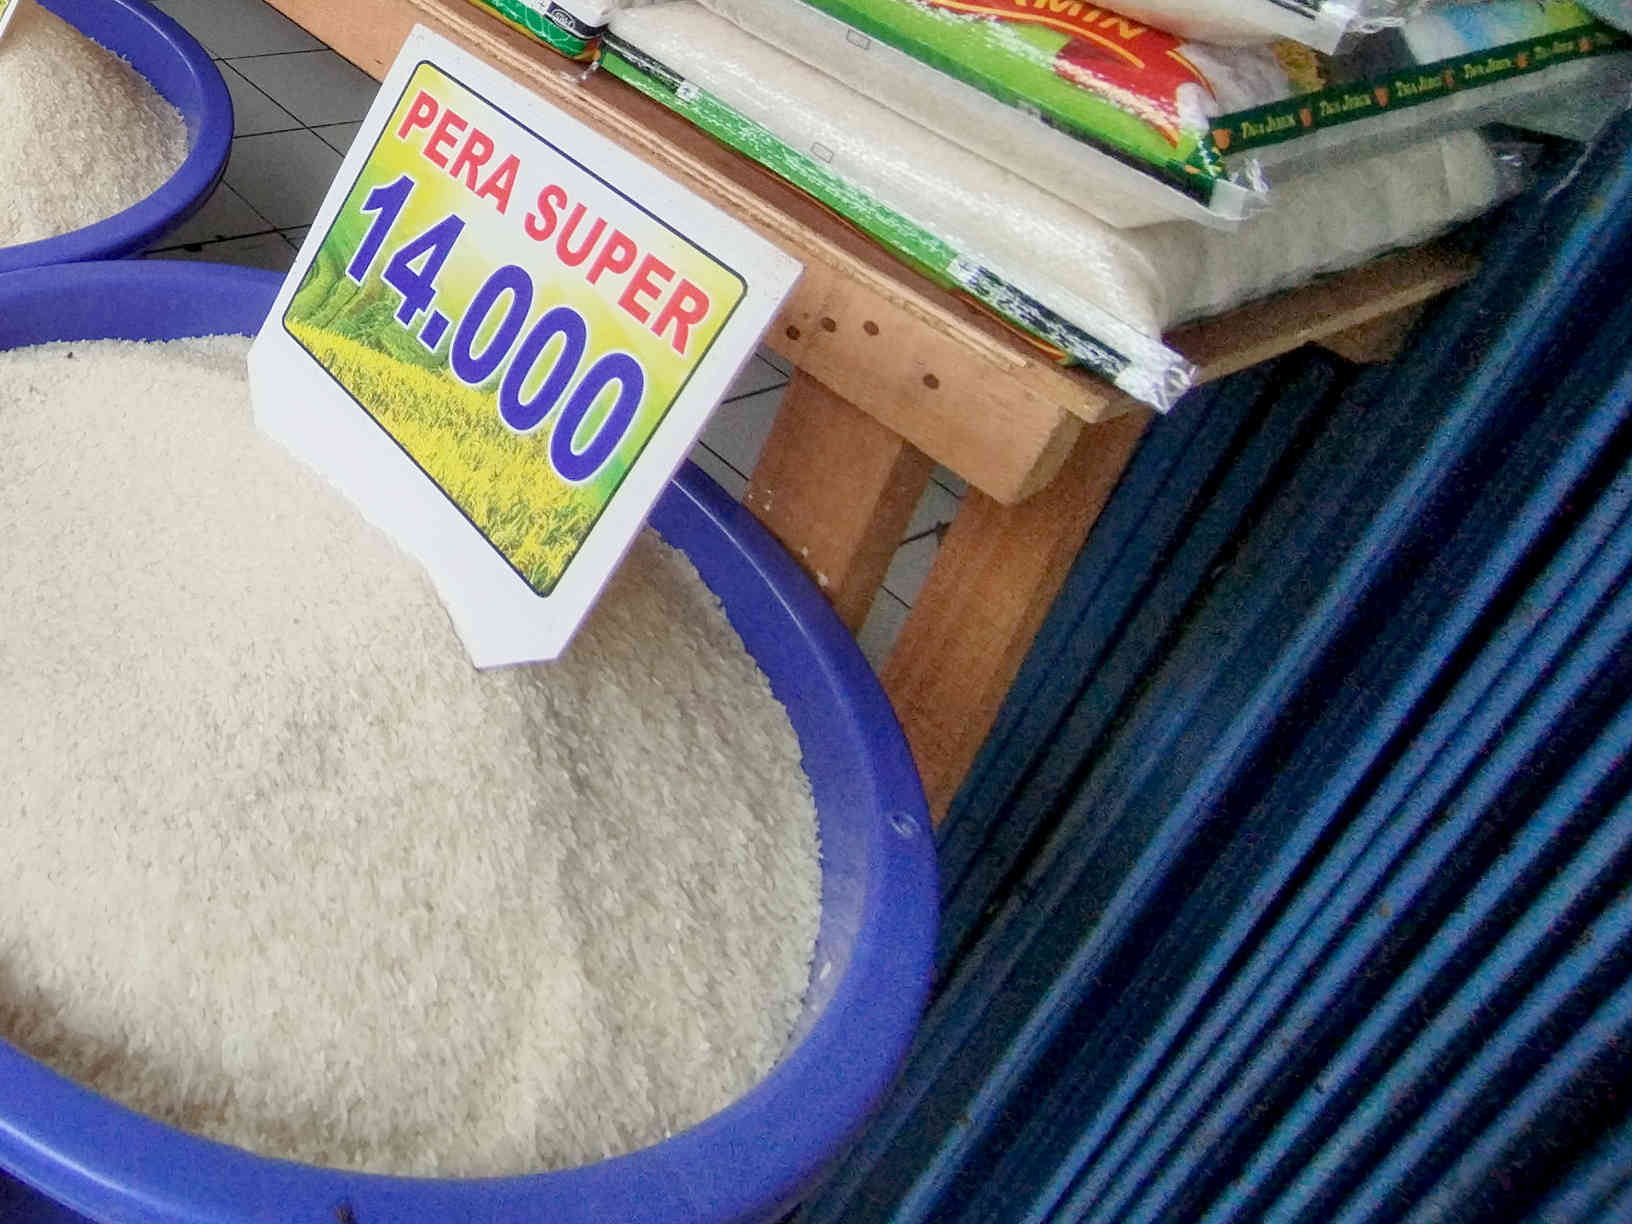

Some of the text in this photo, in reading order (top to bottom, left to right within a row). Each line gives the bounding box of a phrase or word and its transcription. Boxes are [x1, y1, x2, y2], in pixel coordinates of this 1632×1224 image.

[344, 174, 647, 484] 14.000
[395, 89, 712, 357] PERA SUPER
